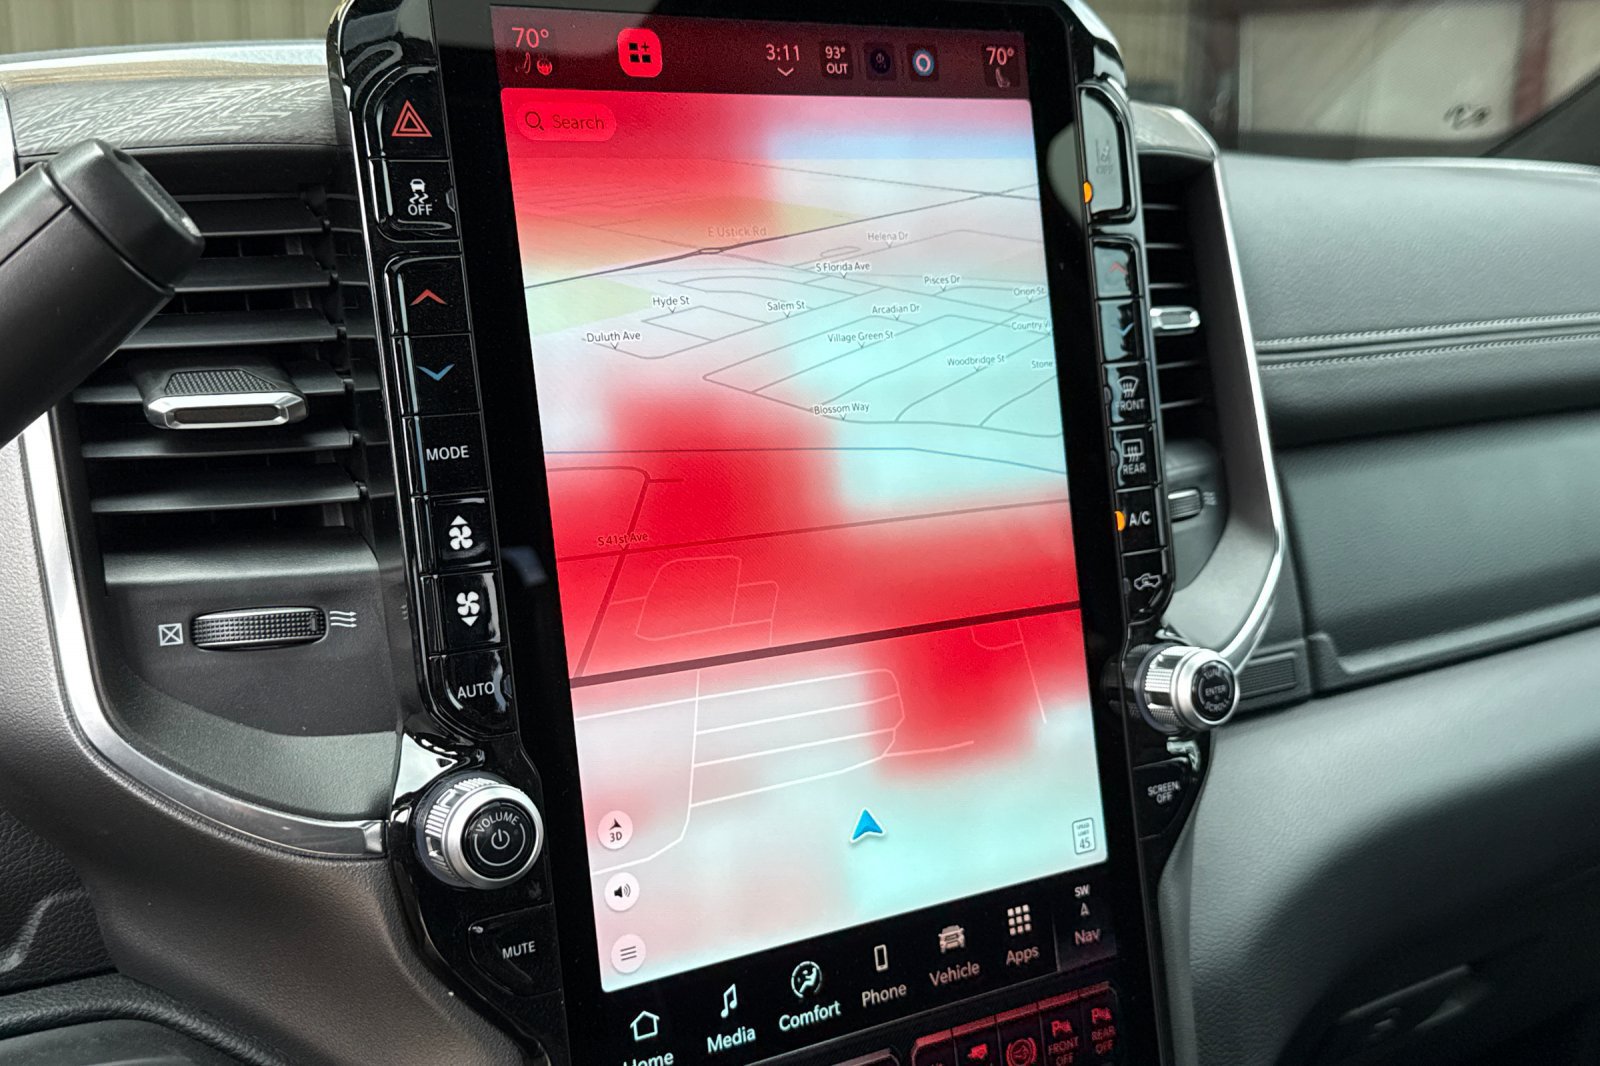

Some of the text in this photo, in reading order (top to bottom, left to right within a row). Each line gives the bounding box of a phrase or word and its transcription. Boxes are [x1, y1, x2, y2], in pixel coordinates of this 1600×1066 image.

[511, 27, 549, 48] 70°
[765, 43, 800, 61] 3:11
[825, 45, 846, 59] 93°
[986, 47, 1014, 65] 70°
[826, 63, 848, 75] OUT
[552, 115, 605, 130] Search
[407, 203, 433, 216] OFF
[708, 226, 767, 238] E Ustick Rd
[867, 231, 908, 242] Helena Dr
[816, 261, 870, 272] S Florida Ave
[924, 274, 960, 285] Pisces Dr
[1037, 286, 1046, 295] St
[652, 295, 689, 306] Hyde St
[767, 300, 805, 312] Salem St
[872, 304, 920, 315] Arcadian Dr
[1011, 320, 1042, 331] Country
[586, 331, 641, 343] Duluth Ave
[827, 330, 893, 343] Village Green St
[947, 354, 1005, 366] Woodbridge St
[1031, 359, 1053, 369] Stone
[814, 402, 870, 415] Blossom Way
[426, 445, 470, 461] MODE
[1122, 461, 1147, 475] REAR
[1129, 510, 1151, 526] A/C
[597, 532, 647, 546] S 41st Ave
[457, 681, 495, 699] AUTO
[1205, 686, 1226, 697] ENTER
[1147, 780, 1180, 797] SCREEN
[1156, 791, 1173, 804] OFF
[475, 811, 519, 834] VOLUME
[609, 831, 622, 842] 3D
[1080, 837, 1091, 849] 45
[1074, 884, 1090, 898] SW
[1074, 928, 1101, 945] Nav
[502, 940, 536, 959] MUTE
[1005, 945, 1040, 966] Apps
[929, 961, 981, 987] Vehicle
[861, 983, 907, 1007] Phone
[778, 1000, 841, 1032] Comfort
[706, 1026, 757, 1053] Media
